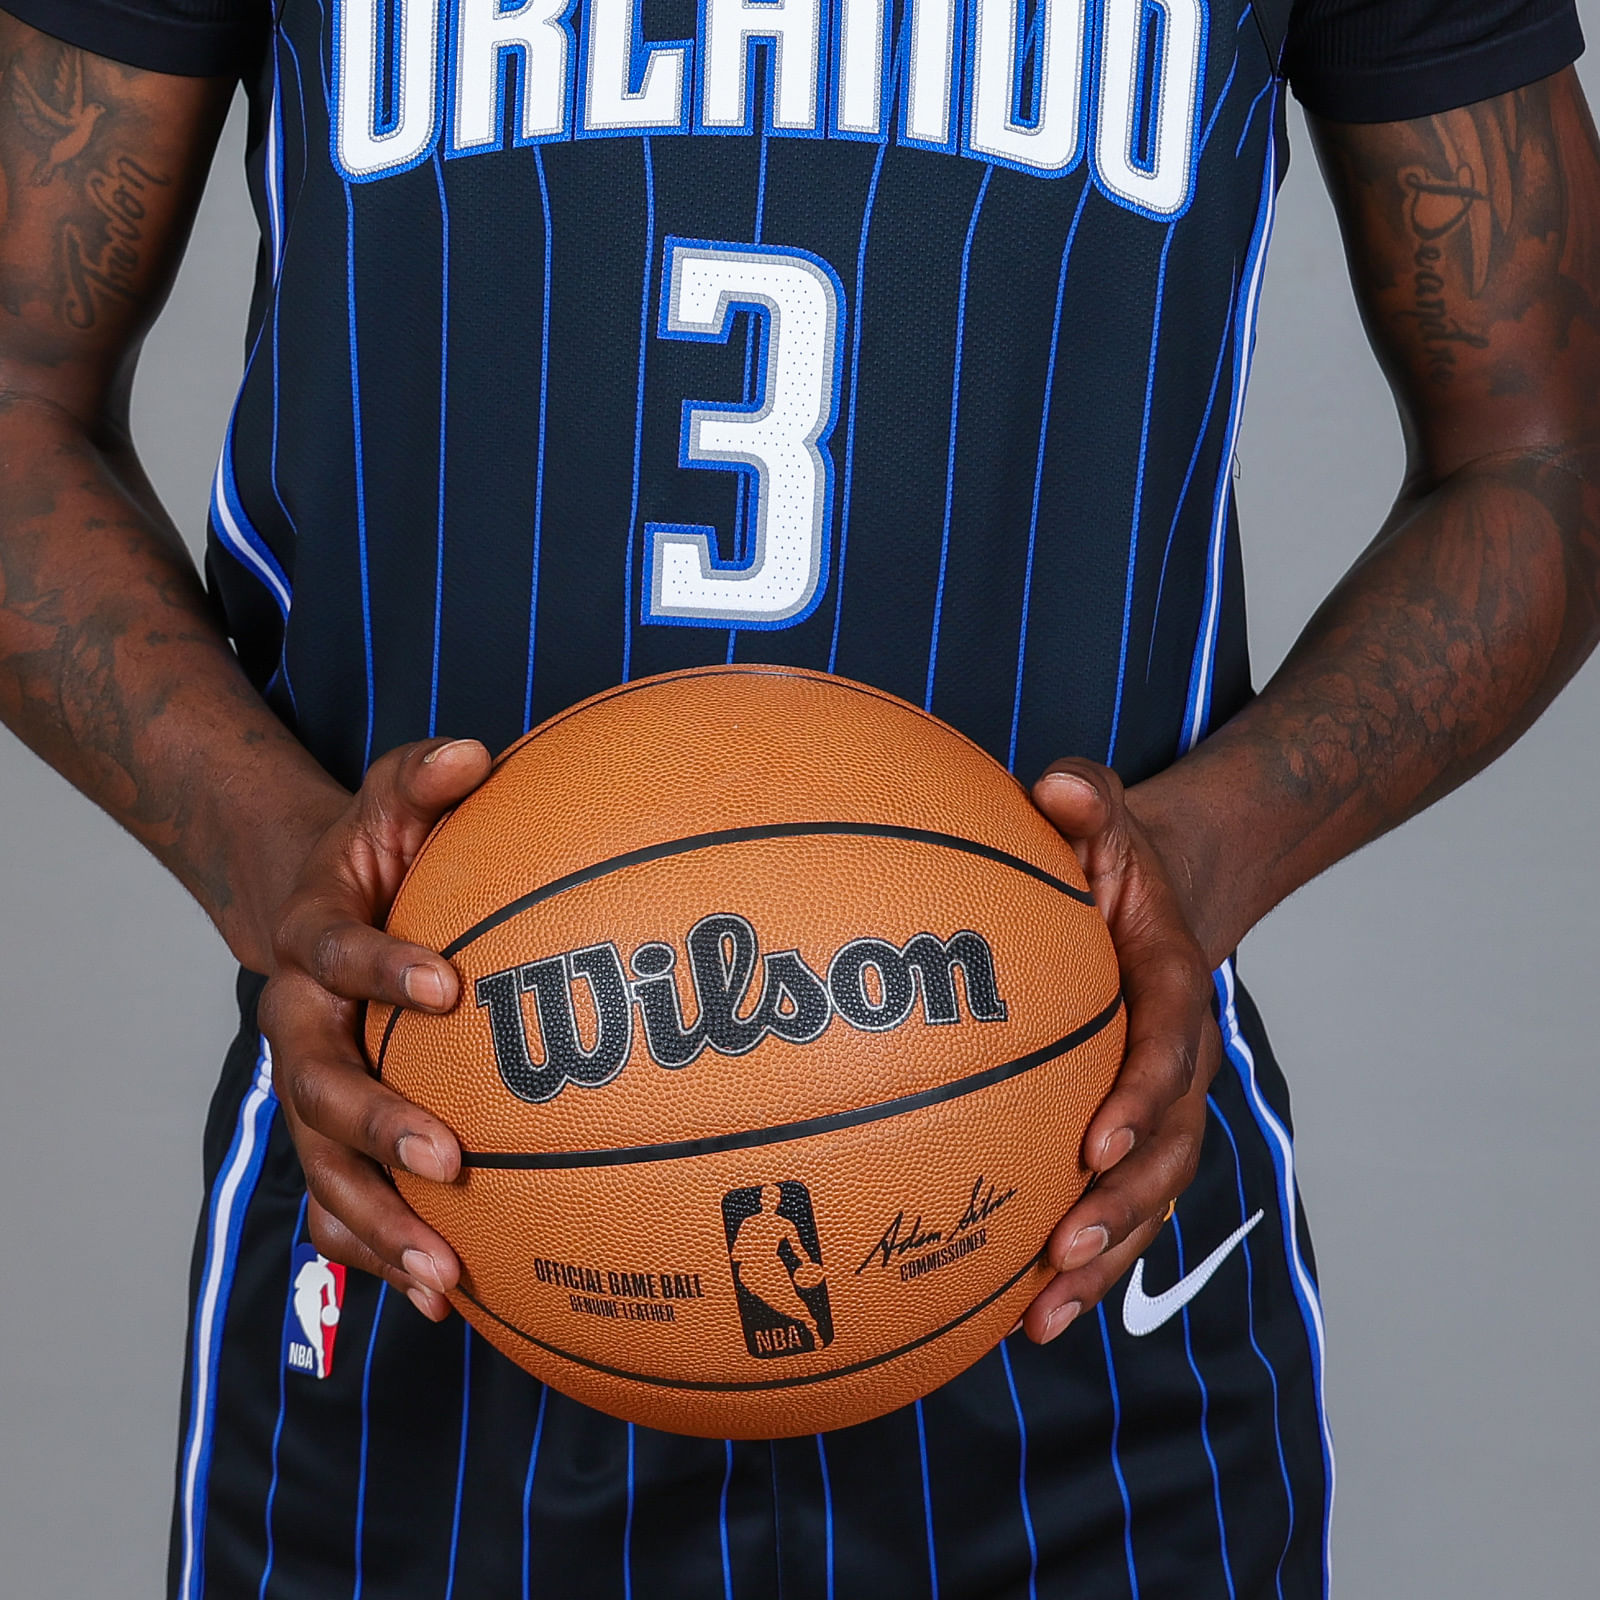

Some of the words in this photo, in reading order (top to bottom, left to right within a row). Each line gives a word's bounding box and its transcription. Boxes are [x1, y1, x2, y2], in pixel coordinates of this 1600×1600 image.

[641, 235, 846, 631] 3
[475, 912, 1008, 1104] Wilson
[900, 1229, 987, 1282] COMMISSIONER
[534, 1258, 607, 1294] OFFICIAL
[608, 1271, 659, 1299] GAME
[660, 1273, 705, 1299] BALL
[569, 1294, 620, 1319] GENUINE
[621, 1301, 676, 1322] LEATHER
[288, 1342, 314, 1370] NBA
[755, 1324, 803, 1354] NBA
